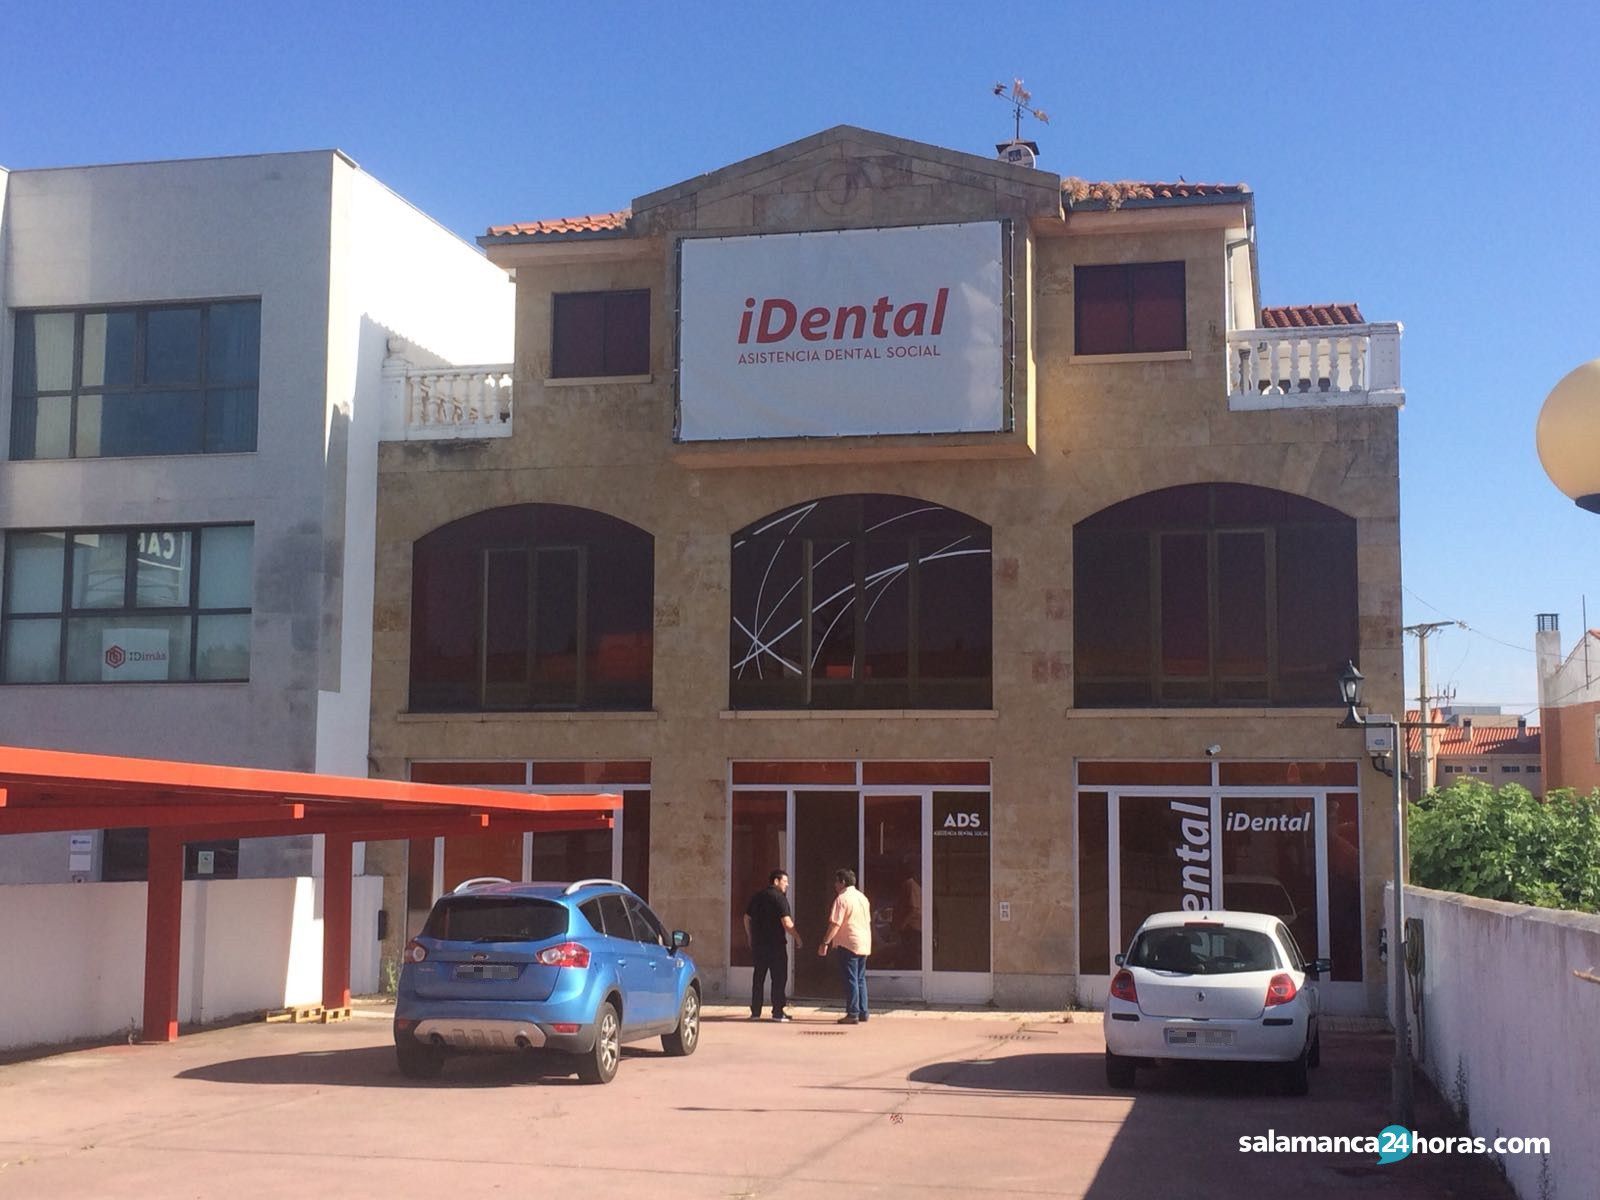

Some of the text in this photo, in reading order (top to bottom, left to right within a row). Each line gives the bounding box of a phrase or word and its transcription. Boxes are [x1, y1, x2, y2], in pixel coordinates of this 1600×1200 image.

[738, 287, 950, 344] iDental
[738, 345, 941, 365] ASISTENCIA DENTAL SOCIAL
[944, 813, 981, 828] ADS
[1226, 811, 1311, 832] iDental
